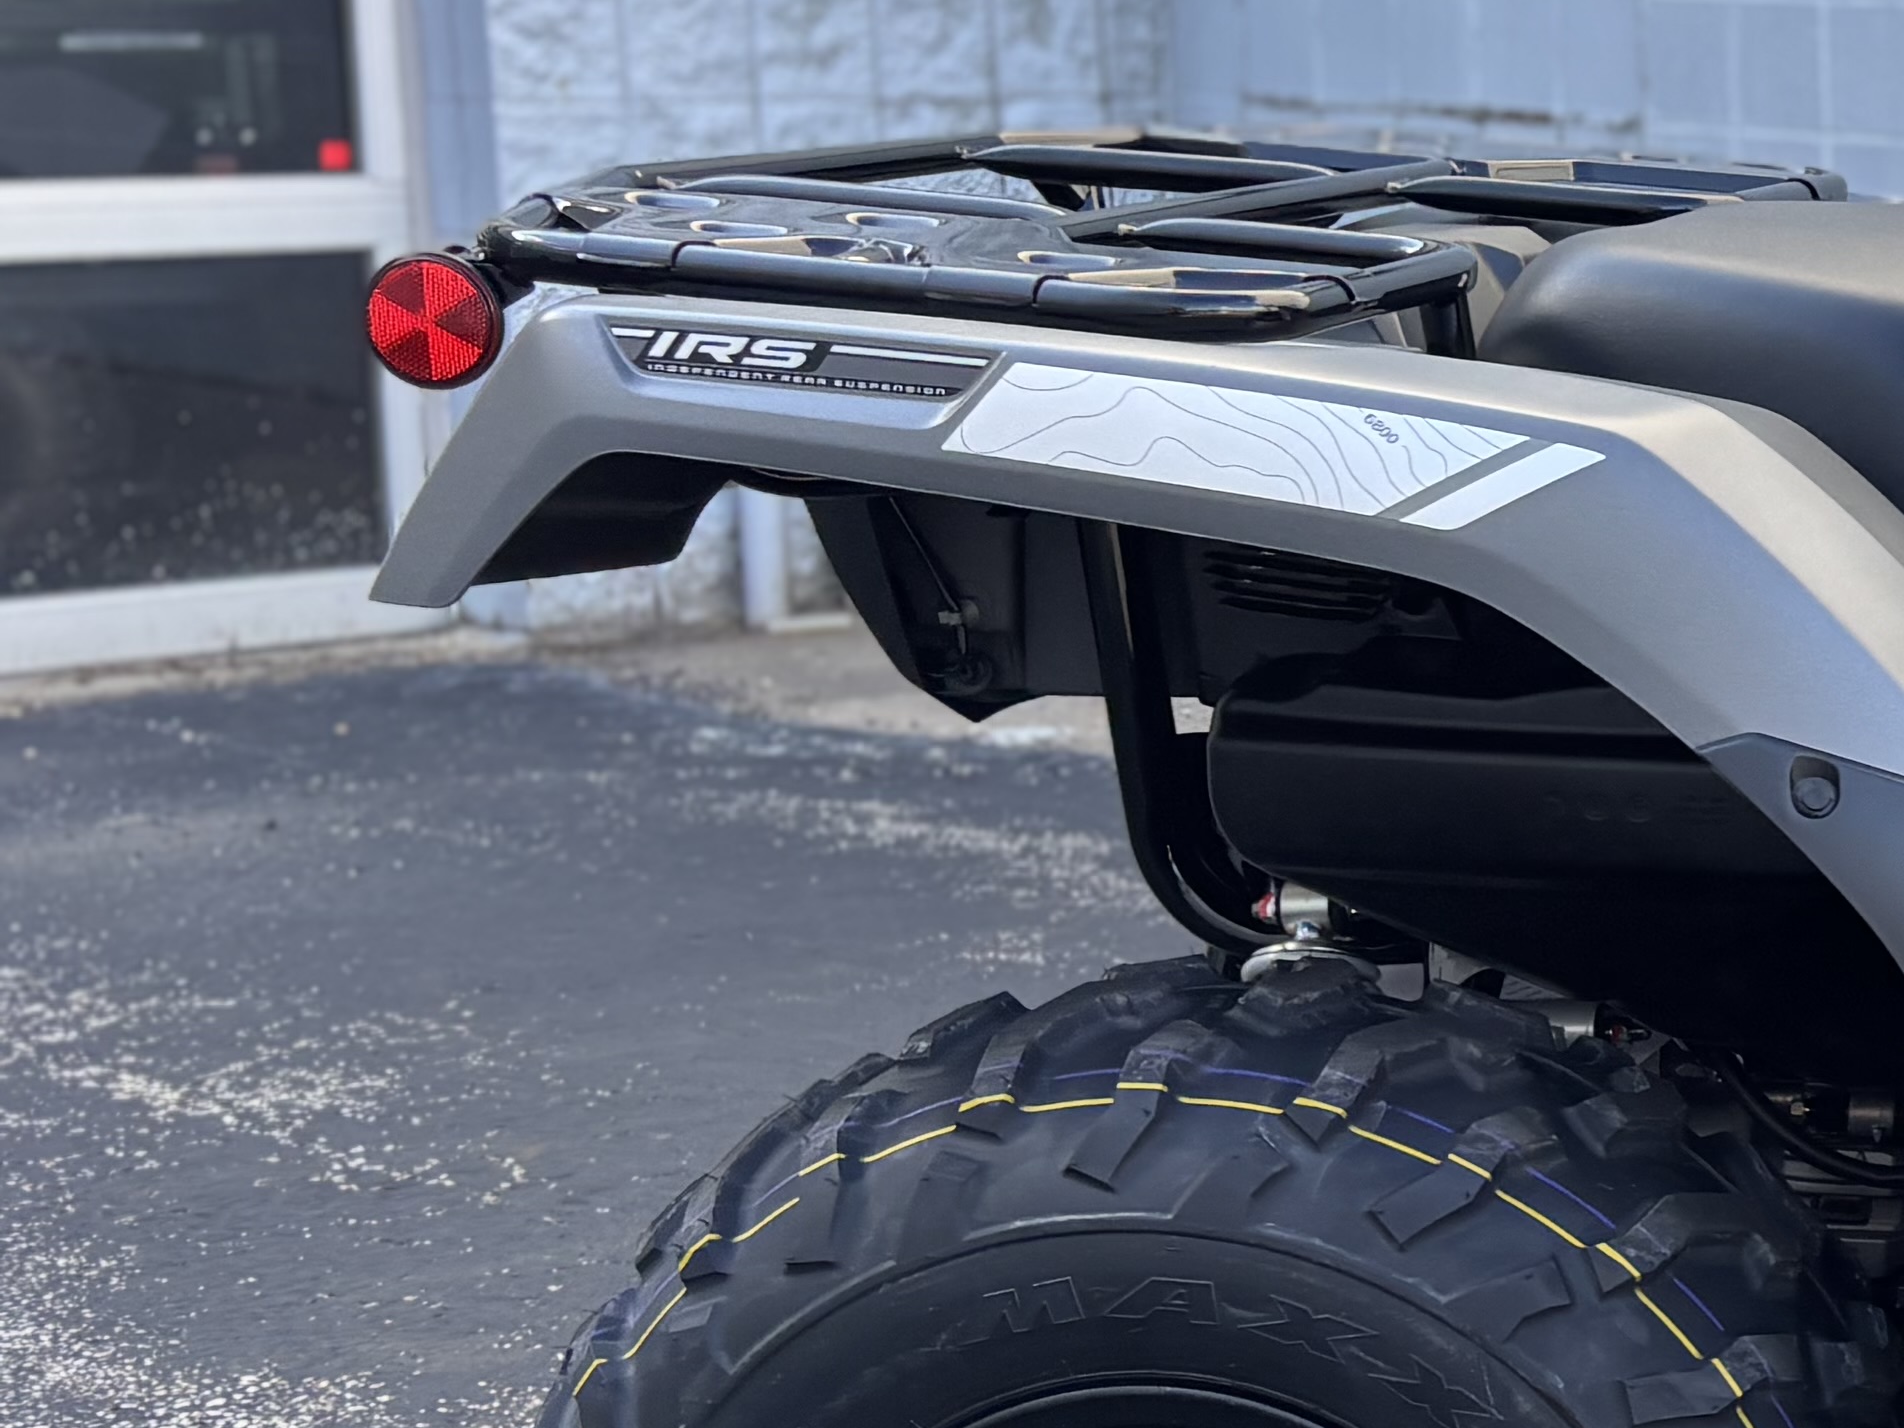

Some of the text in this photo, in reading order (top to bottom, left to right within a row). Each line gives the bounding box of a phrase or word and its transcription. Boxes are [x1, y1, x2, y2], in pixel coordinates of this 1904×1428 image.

[647, 330, 816, 370] IRS
[646, 363, 947, 396] INDEPENDENT REAR SUSPENSION
